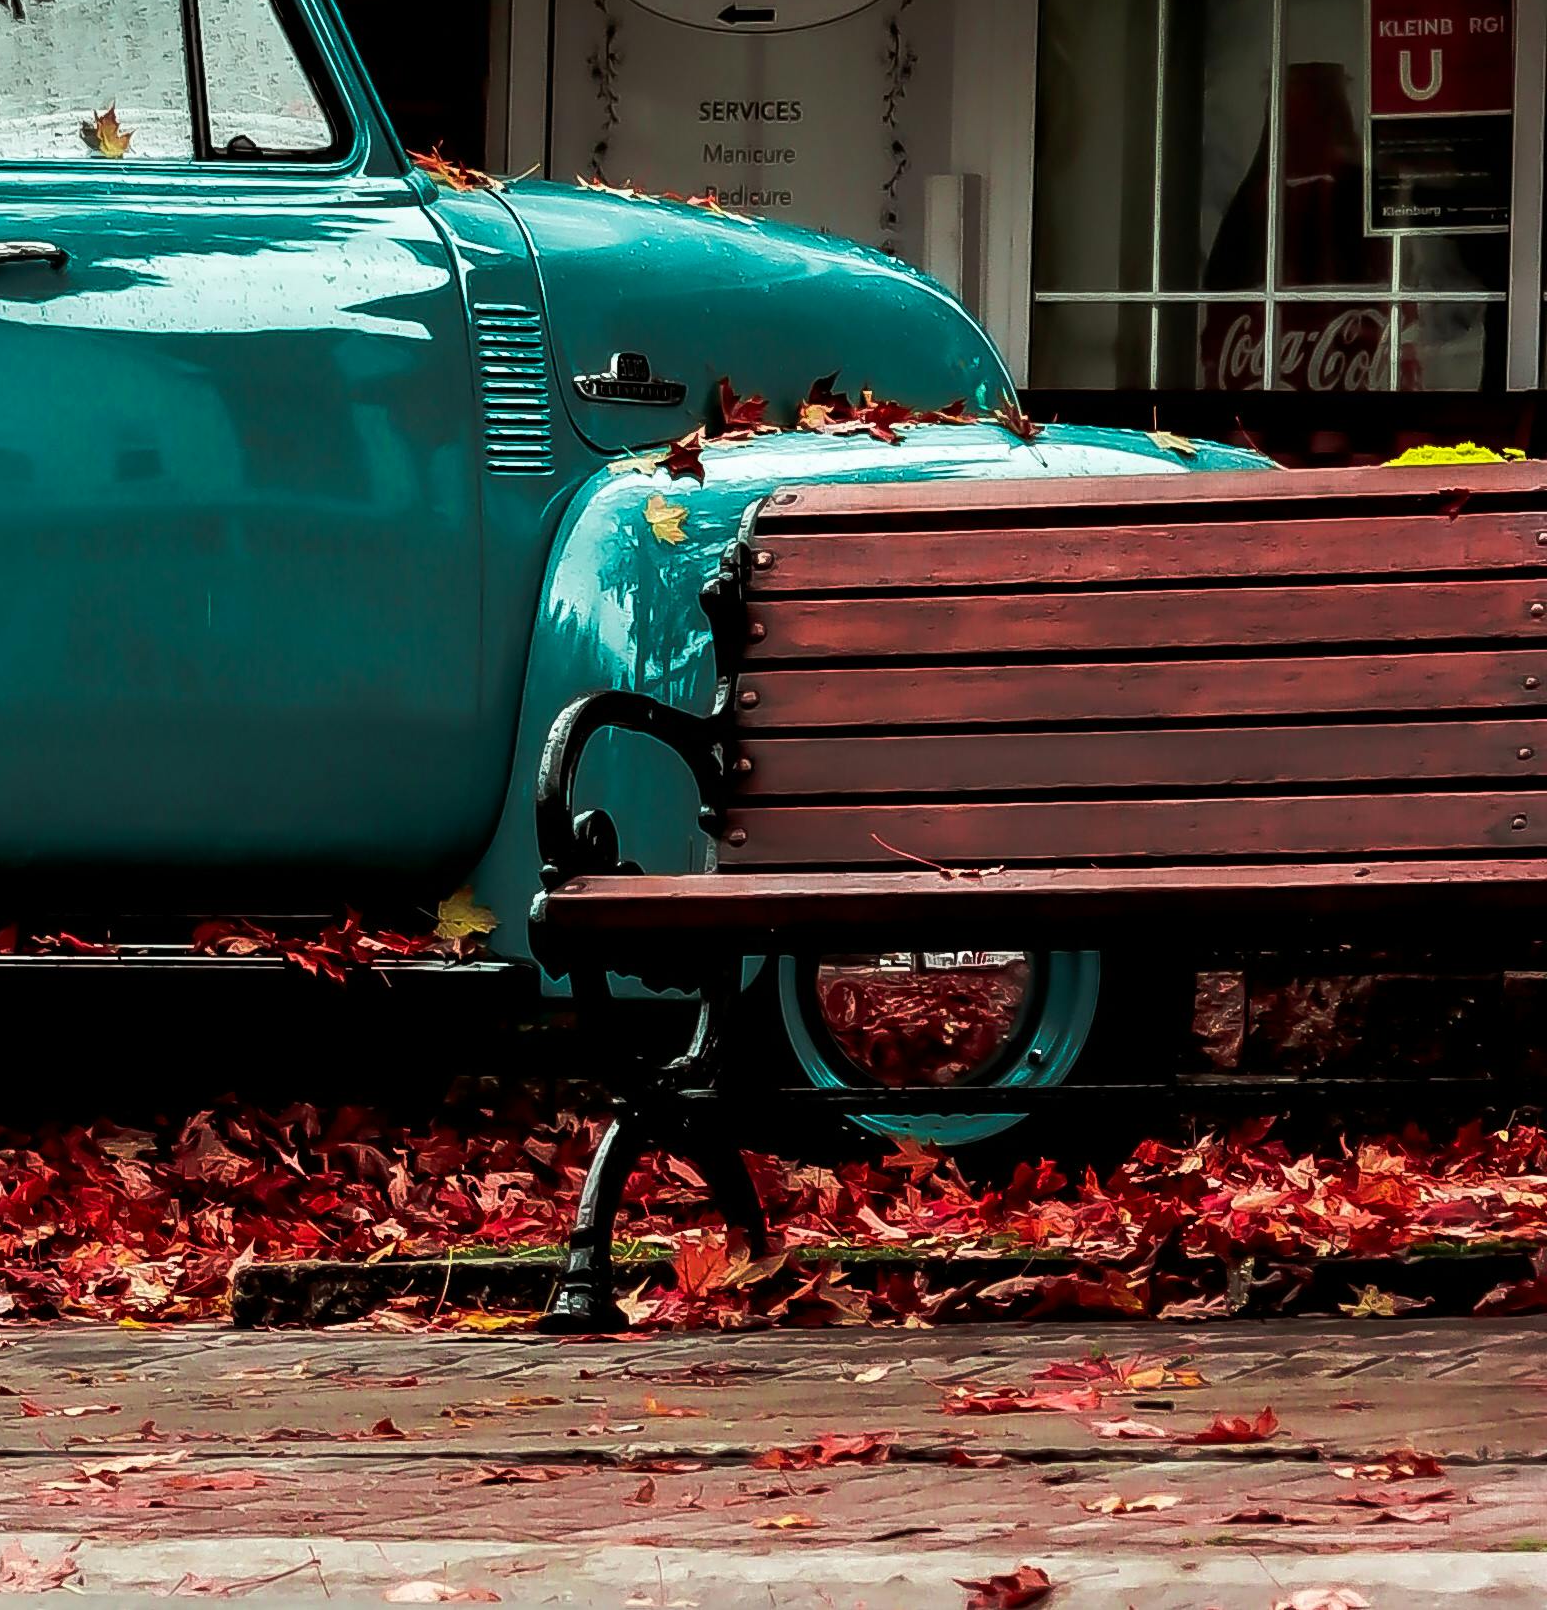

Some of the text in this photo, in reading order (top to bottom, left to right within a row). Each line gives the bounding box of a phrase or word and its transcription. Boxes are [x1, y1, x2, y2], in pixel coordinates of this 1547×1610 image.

[1378, 18, 1453, 38] KLEINB
[1399, 48, 1443, 102] U
[698, 100, 802, 123] SERVICES
[702, 144, 796, 165] Manicure
